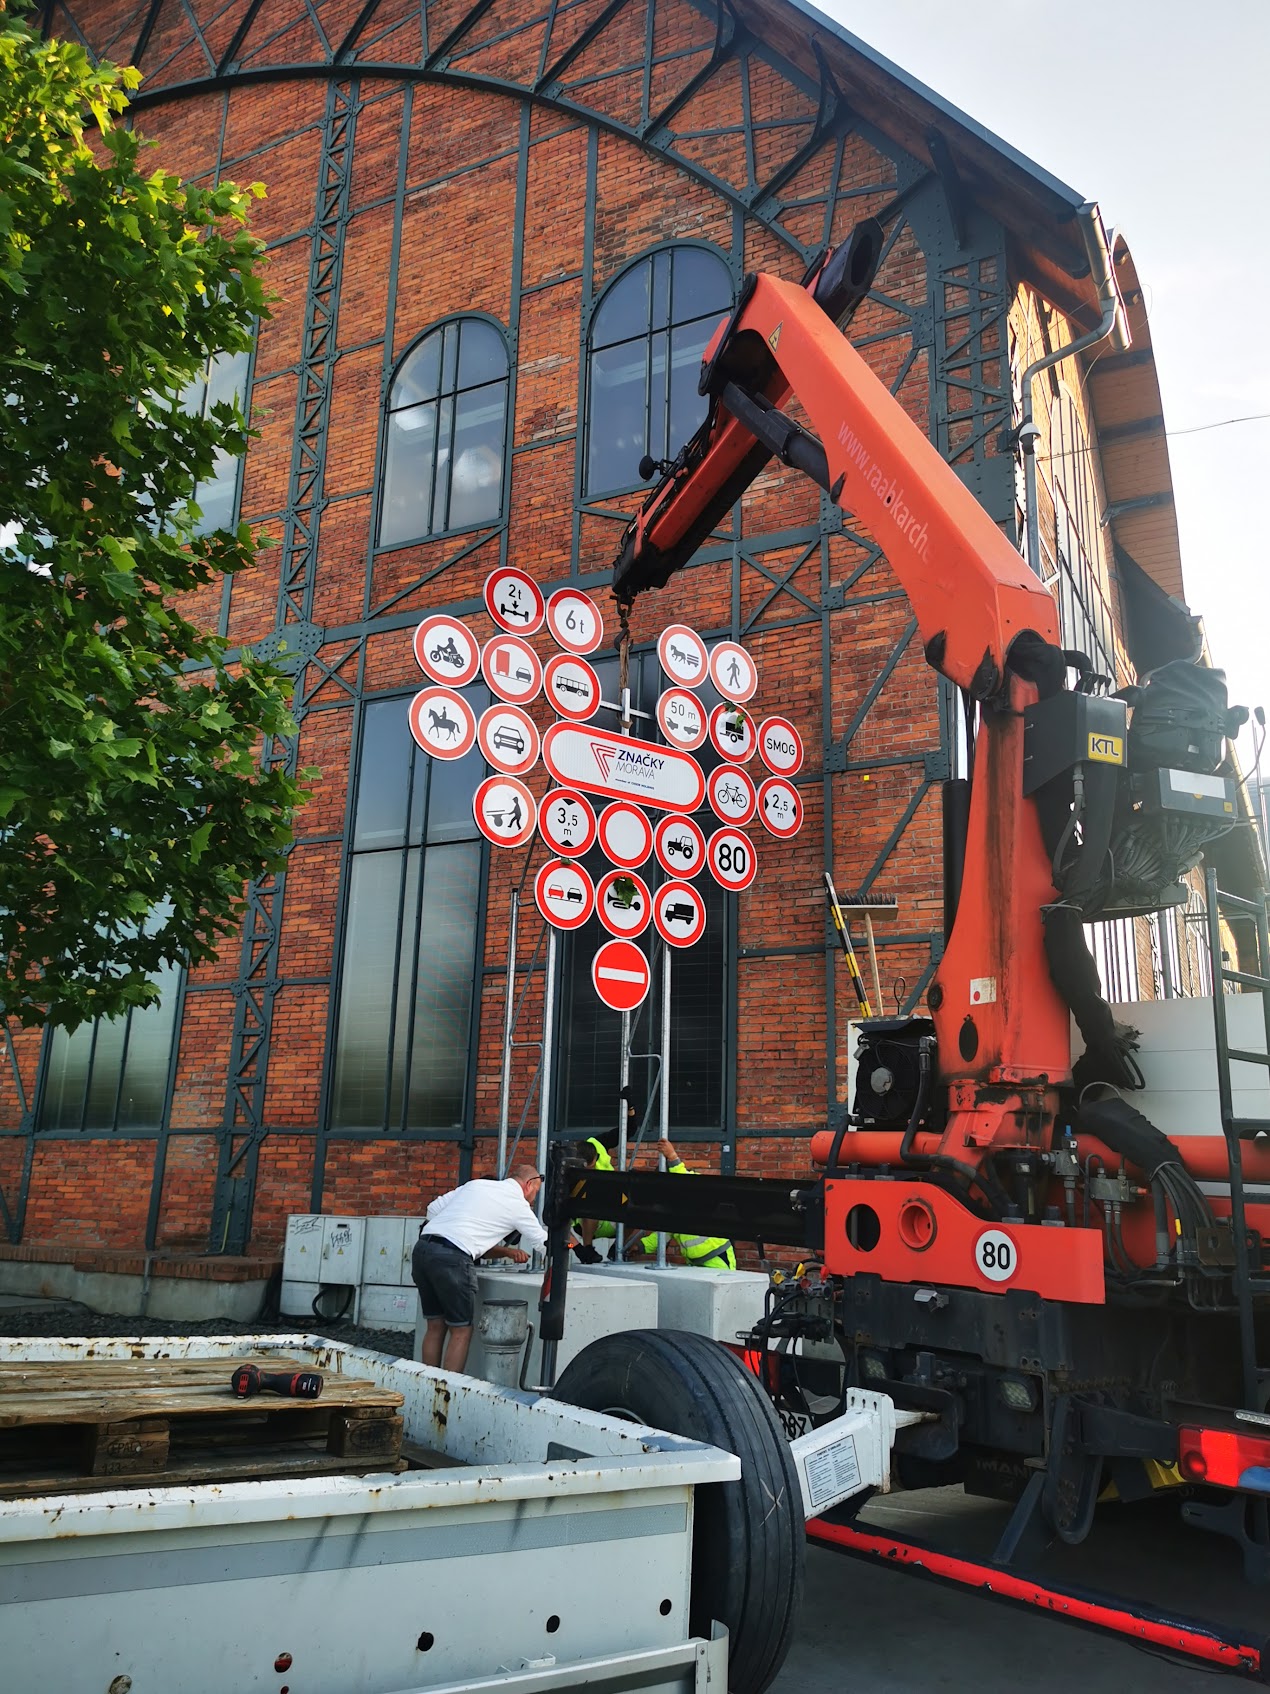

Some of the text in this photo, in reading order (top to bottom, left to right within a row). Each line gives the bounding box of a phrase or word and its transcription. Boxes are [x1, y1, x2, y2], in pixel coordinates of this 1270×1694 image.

[766, 738, 796, 756] SMOG
[1091, 737, 1119, 757] KTL
[617, 749, 665, 770] ZNAČKY
[615, 761, 655, 780] MORAVA
[557, 807, 578, 827] 3,5
[563, 828, 572, 836] m
[718, 843, 746, 874] 80
[982, 1241, 1011, 1270] 80
